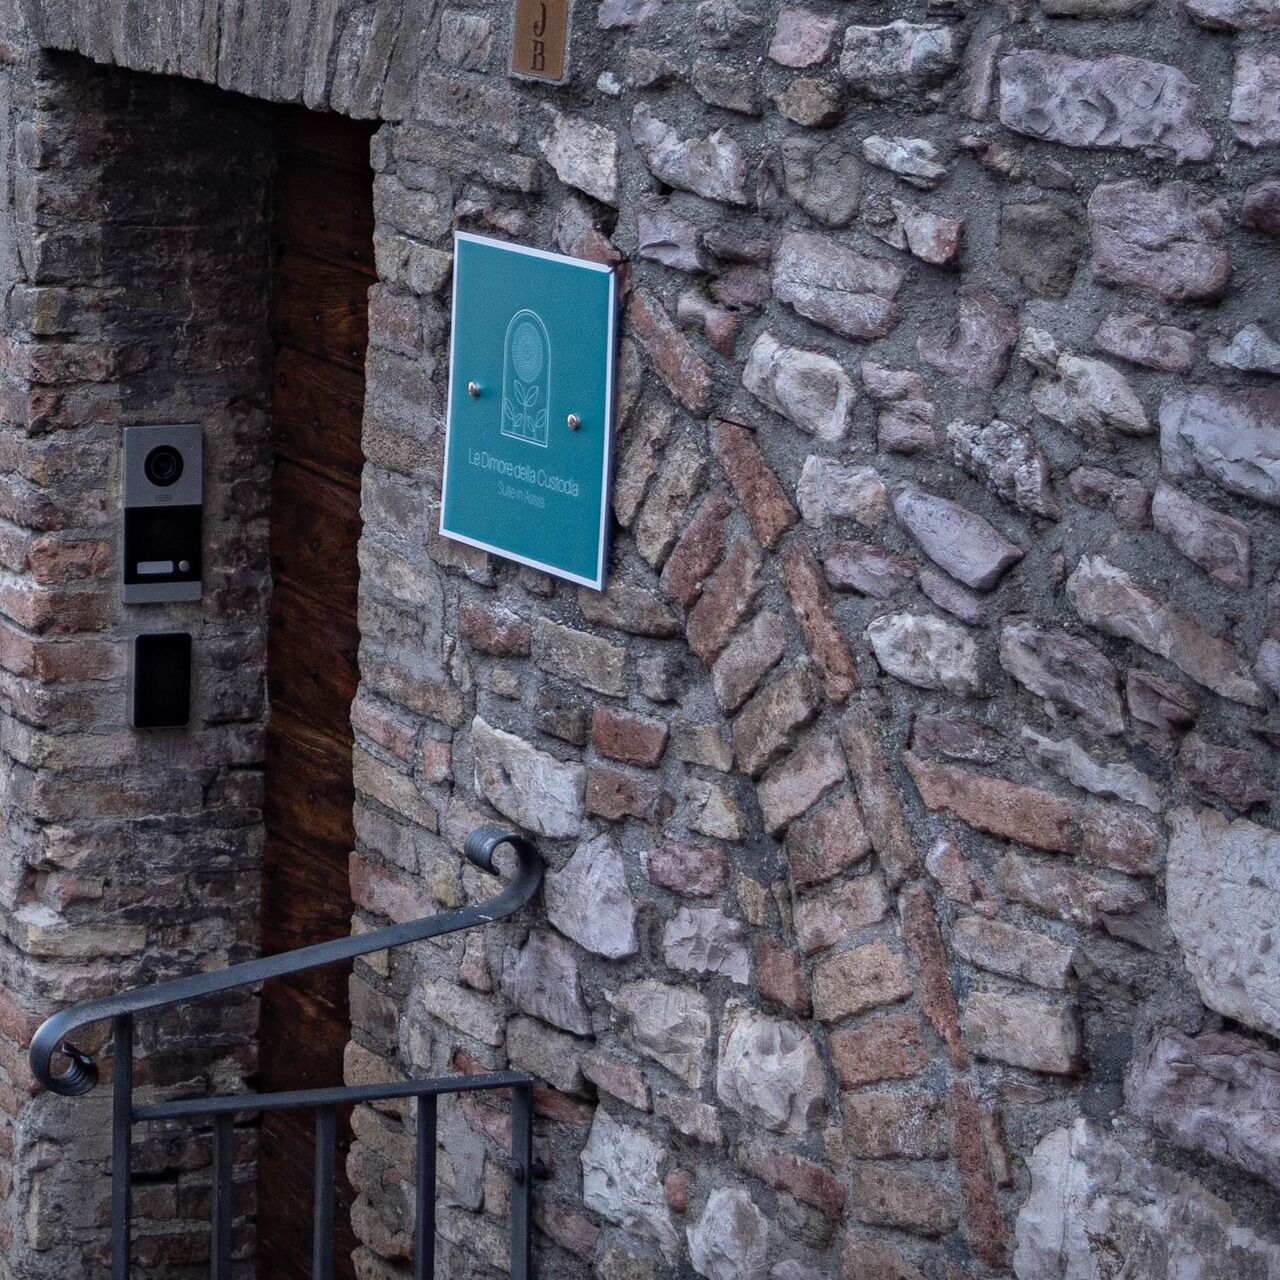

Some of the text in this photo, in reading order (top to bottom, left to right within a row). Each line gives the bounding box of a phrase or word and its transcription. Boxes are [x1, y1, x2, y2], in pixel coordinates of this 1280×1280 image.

[530, 40, 546, 71] B
[468, 447, 579, 497] Le Dimore della Custodia
